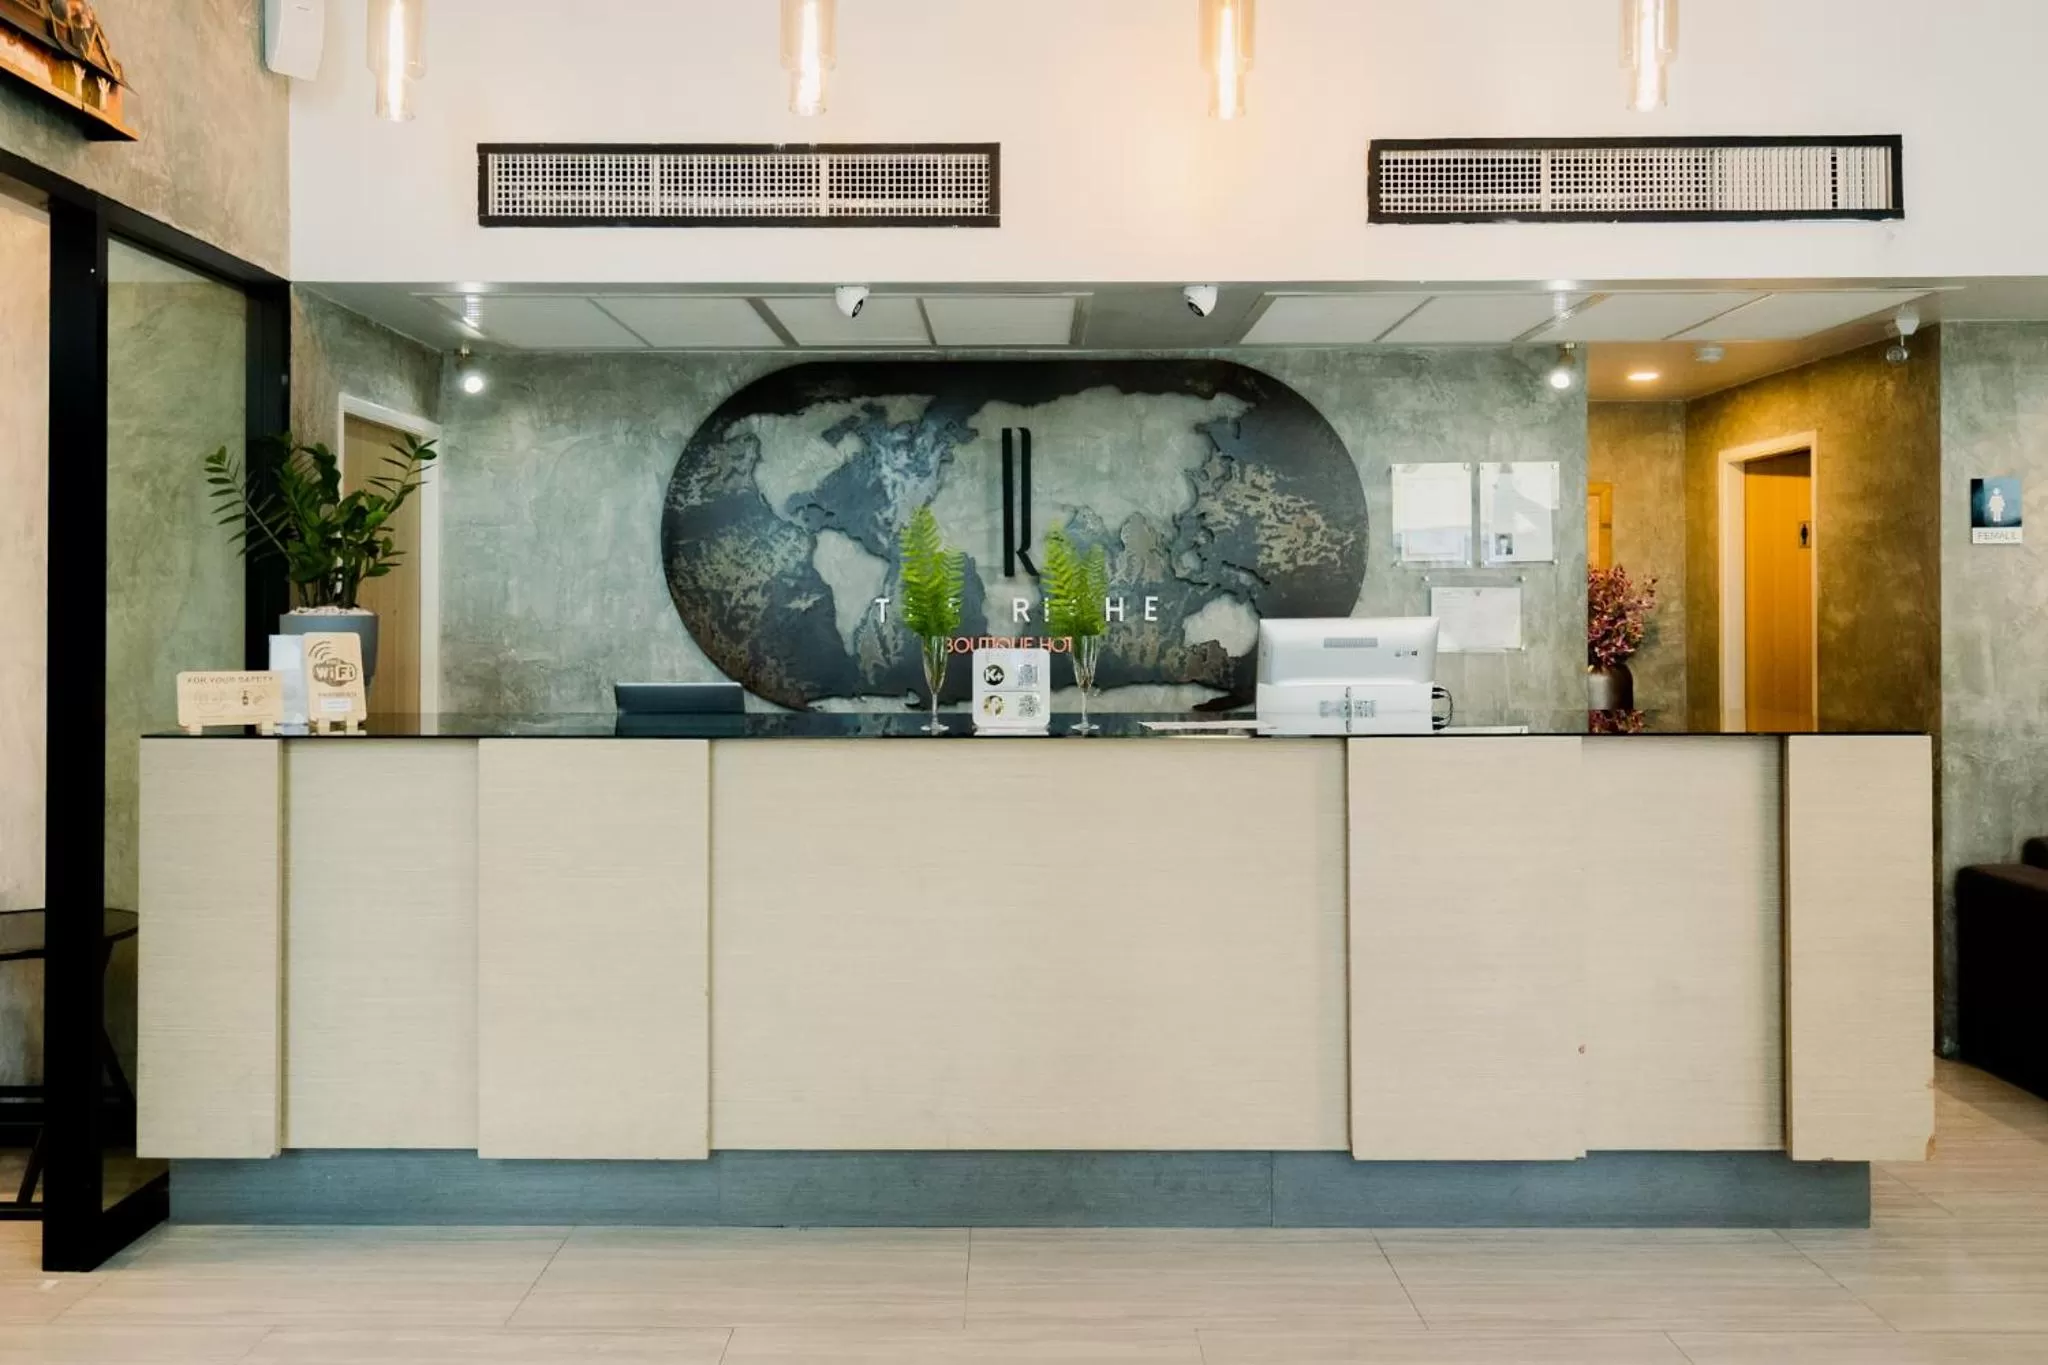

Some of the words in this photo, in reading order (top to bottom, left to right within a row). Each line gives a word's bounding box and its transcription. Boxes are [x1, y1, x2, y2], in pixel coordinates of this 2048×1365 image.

[1977, 531, 2019, 541] FEMALE
[1013, 597, 1158, 623] RIHE
[1038, 636, 1072, 654] HOT
[187, 675, 208, 684] FOR
[209, 675, 236, 684] YOUR
[238, 675, 273, 684] SAFETY
